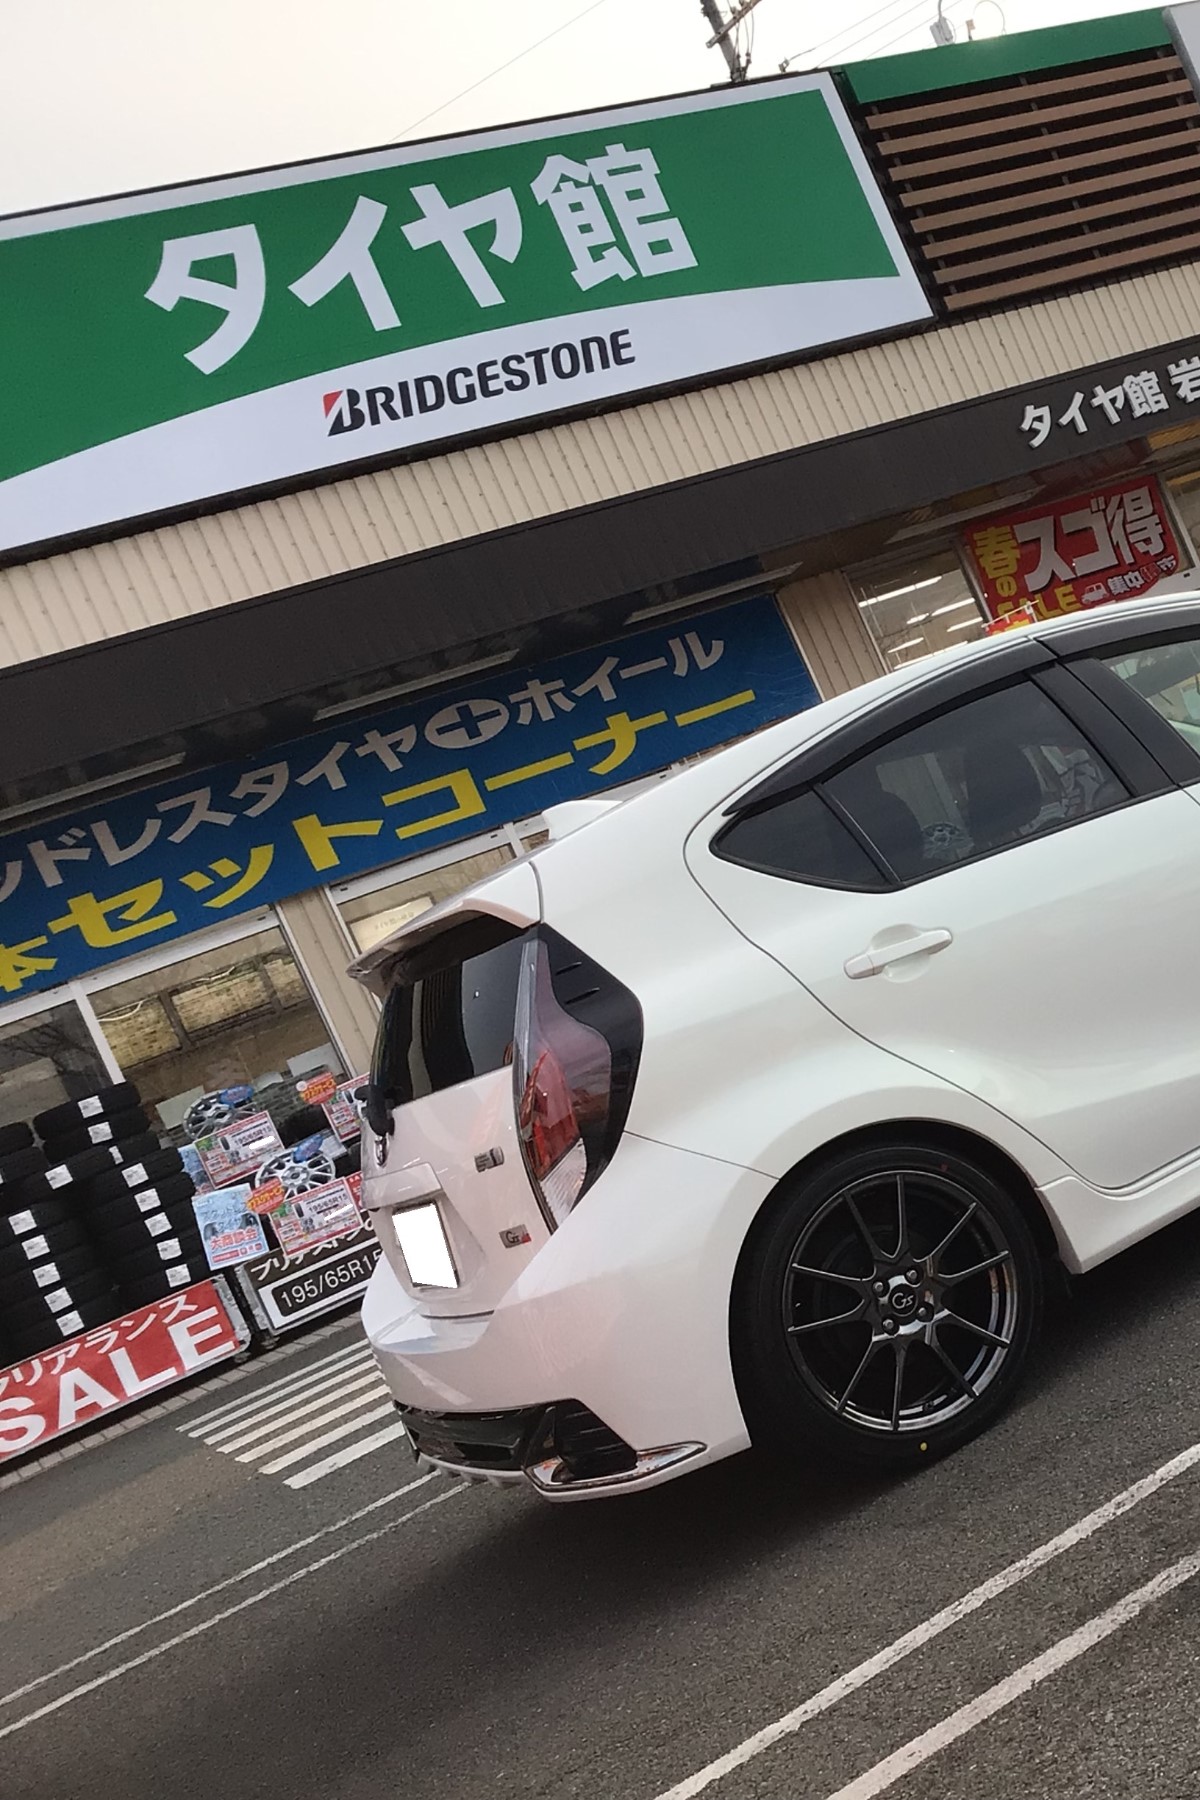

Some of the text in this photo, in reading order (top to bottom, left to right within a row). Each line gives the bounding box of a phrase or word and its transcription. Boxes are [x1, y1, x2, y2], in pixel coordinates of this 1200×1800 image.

[144, 143, 700, 375] タイヤ館
[323, 328, 636, 437] BRIDGESTONE
[1020, 369, 1169, 448] タイヤ館
[1013, 485, 1166, 593] スゴ得
[511, 630, 726, 726] ホイール
[0, 1305, 236, 1455] SALE
